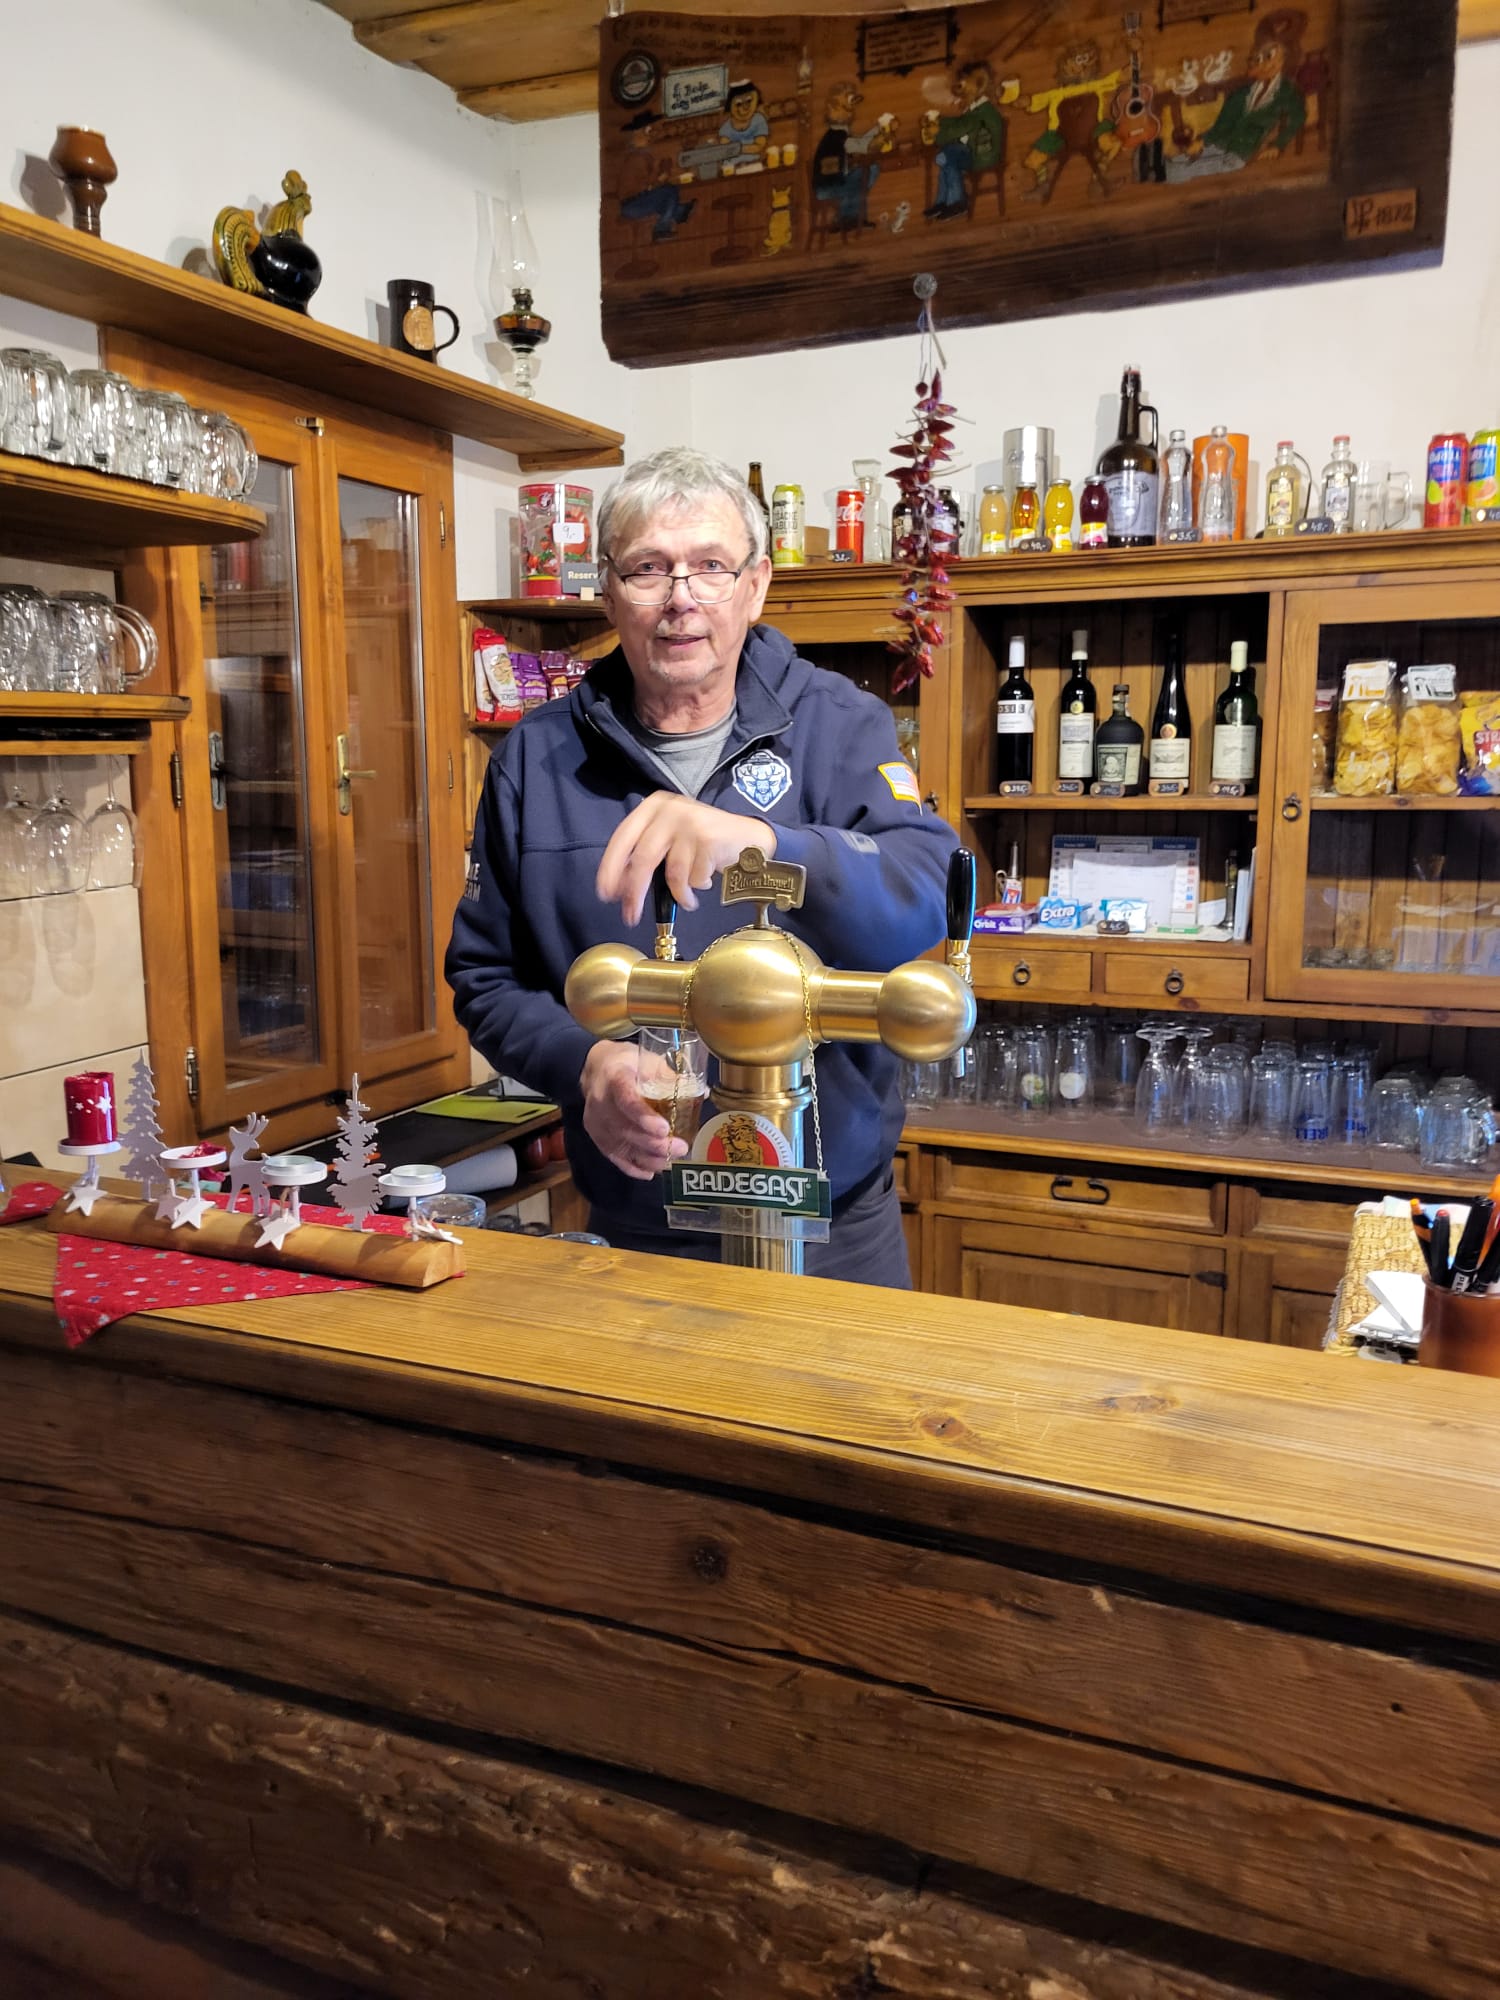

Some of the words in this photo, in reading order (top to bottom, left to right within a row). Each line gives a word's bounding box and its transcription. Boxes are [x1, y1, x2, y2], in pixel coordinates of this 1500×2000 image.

[568, 570, 598, 580] Reserv
[973, 918, 996, 929] Orbit
[681, 1168, 809, 1207] RADEGAST
